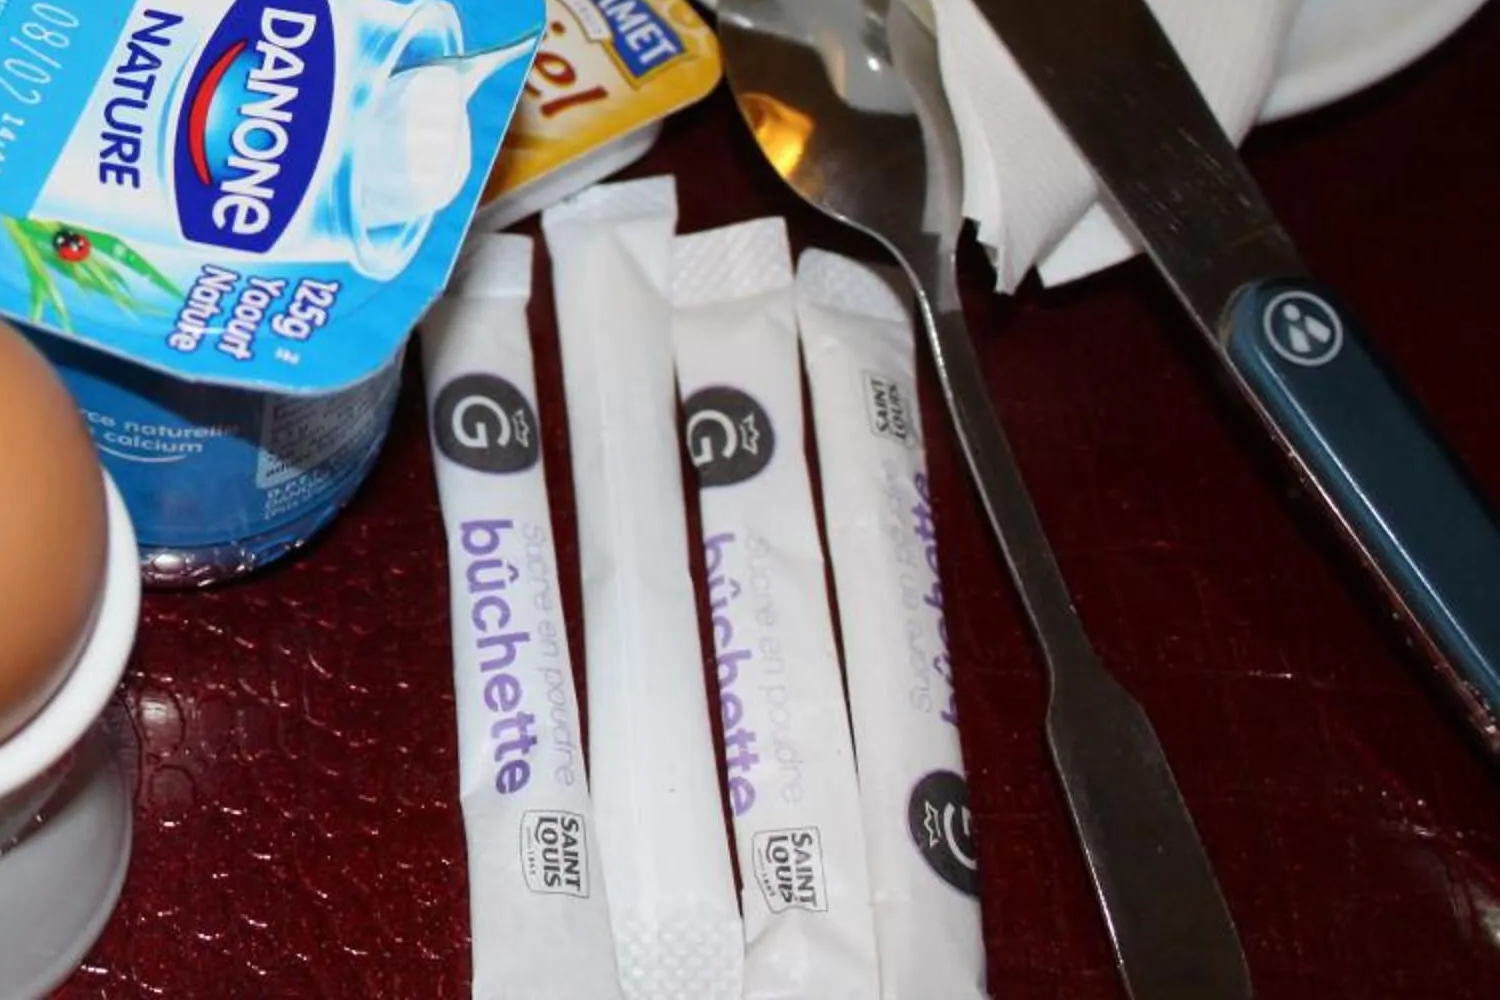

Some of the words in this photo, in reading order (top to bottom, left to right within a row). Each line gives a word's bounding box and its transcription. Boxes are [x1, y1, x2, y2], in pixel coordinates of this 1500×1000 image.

[100, 8, 184, 188] NATURE
[170, 264, 239, 352] Nature
[217, 278, 285, 360] Yaourt
[272, 279, 338, 341] 125g
[104, 433, 203, 453] calcium
[873, 377, 890, 433] SAINT
[518, 522, 557, 616] Sucre
[459, 519, 531, 795] bûchette
[535, 619, 561, 657] en
[537, 663, 583, 788] poudre
[532, 815, 564, 888] LOUIS
[558, 815, 585, 892] SAINT
[764, 835, 794, 904] LOUIS
[791, 831, 819, 908] SAINT
